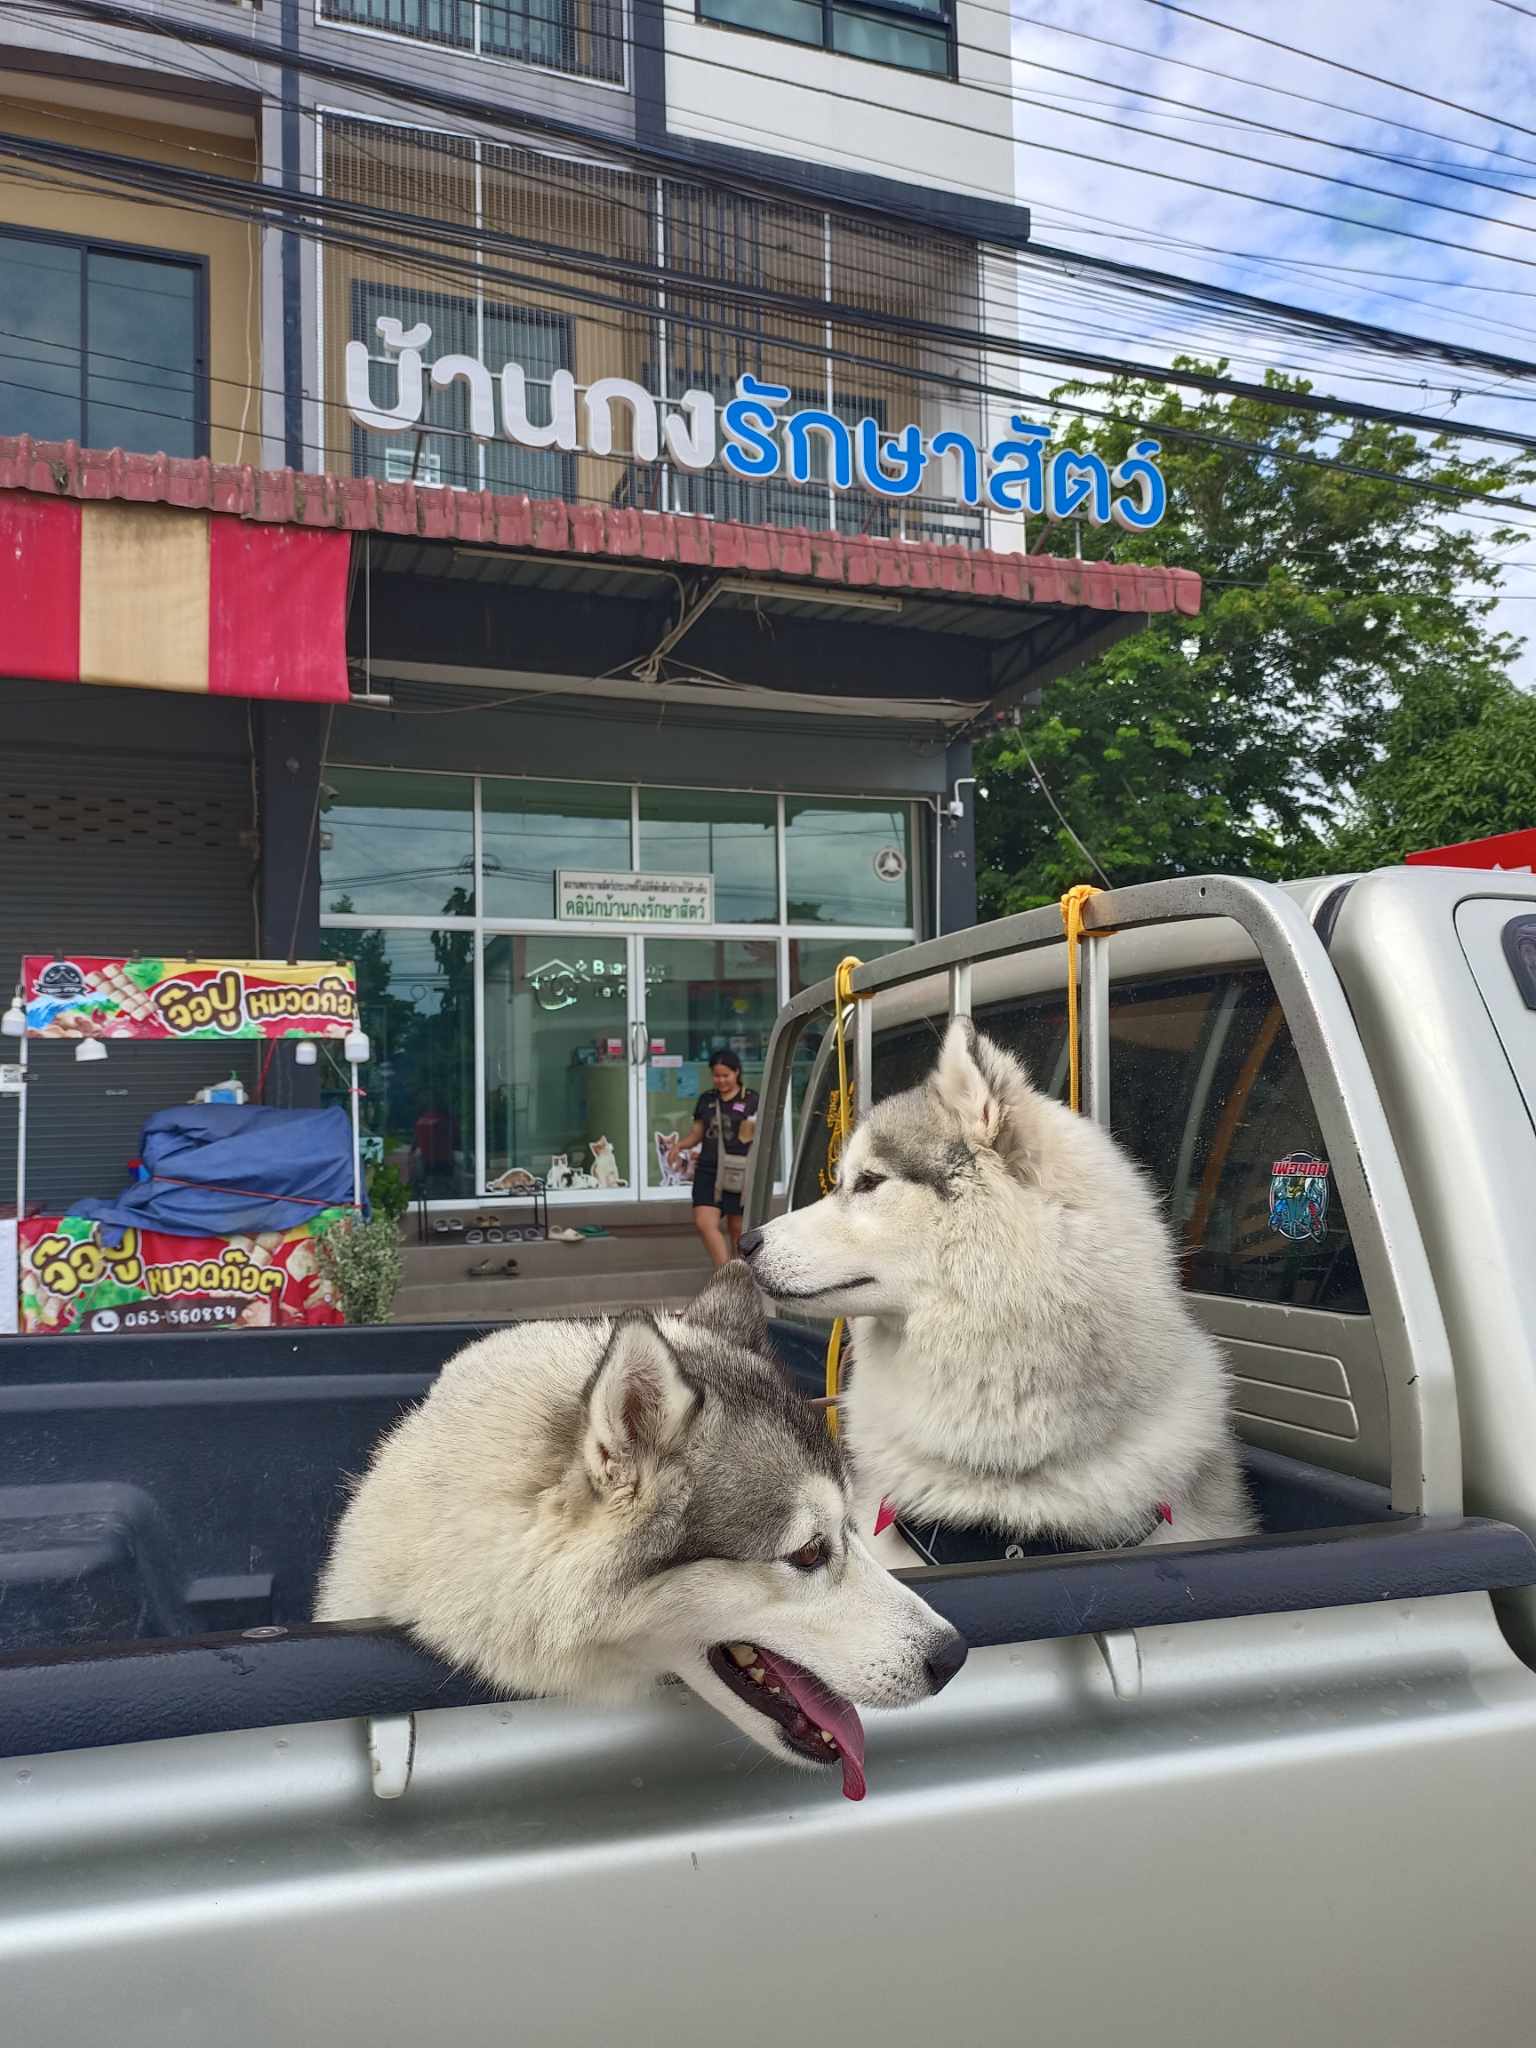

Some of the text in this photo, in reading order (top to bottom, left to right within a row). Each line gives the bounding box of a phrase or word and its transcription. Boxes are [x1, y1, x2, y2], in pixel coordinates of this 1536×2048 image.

[345, 316, 1166, 530] บ้านกงรักษาสัตว์
[565, 893, 706, 919] คลินิกบ้านกงรักษาสัตว์
